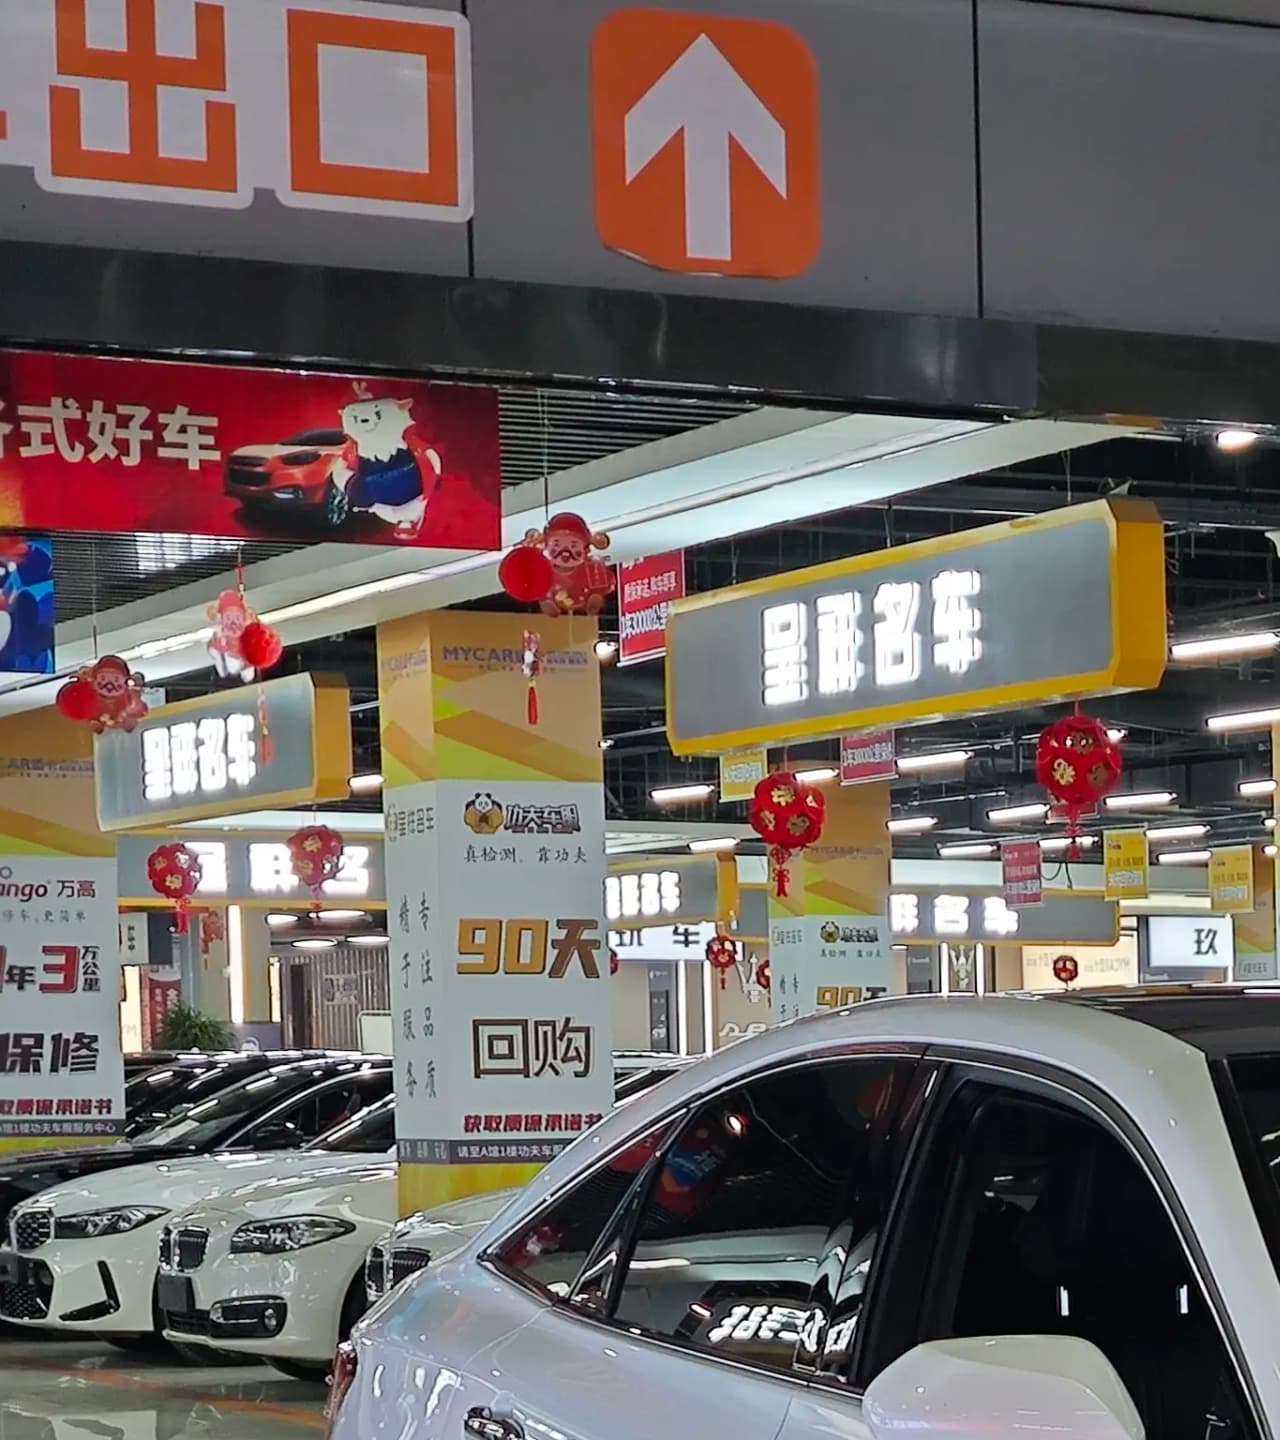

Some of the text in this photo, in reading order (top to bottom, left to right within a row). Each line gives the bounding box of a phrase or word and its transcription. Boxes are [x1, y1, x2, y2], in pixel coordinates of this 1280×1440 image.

[0, 0, 460, 207] 出口
[56, 880, 96, 898] 万高
[455, 918, 601, 979] 90天
[0, 1032, 100, 1073] 保修
[472, 1017, 593, 1078] 回购
